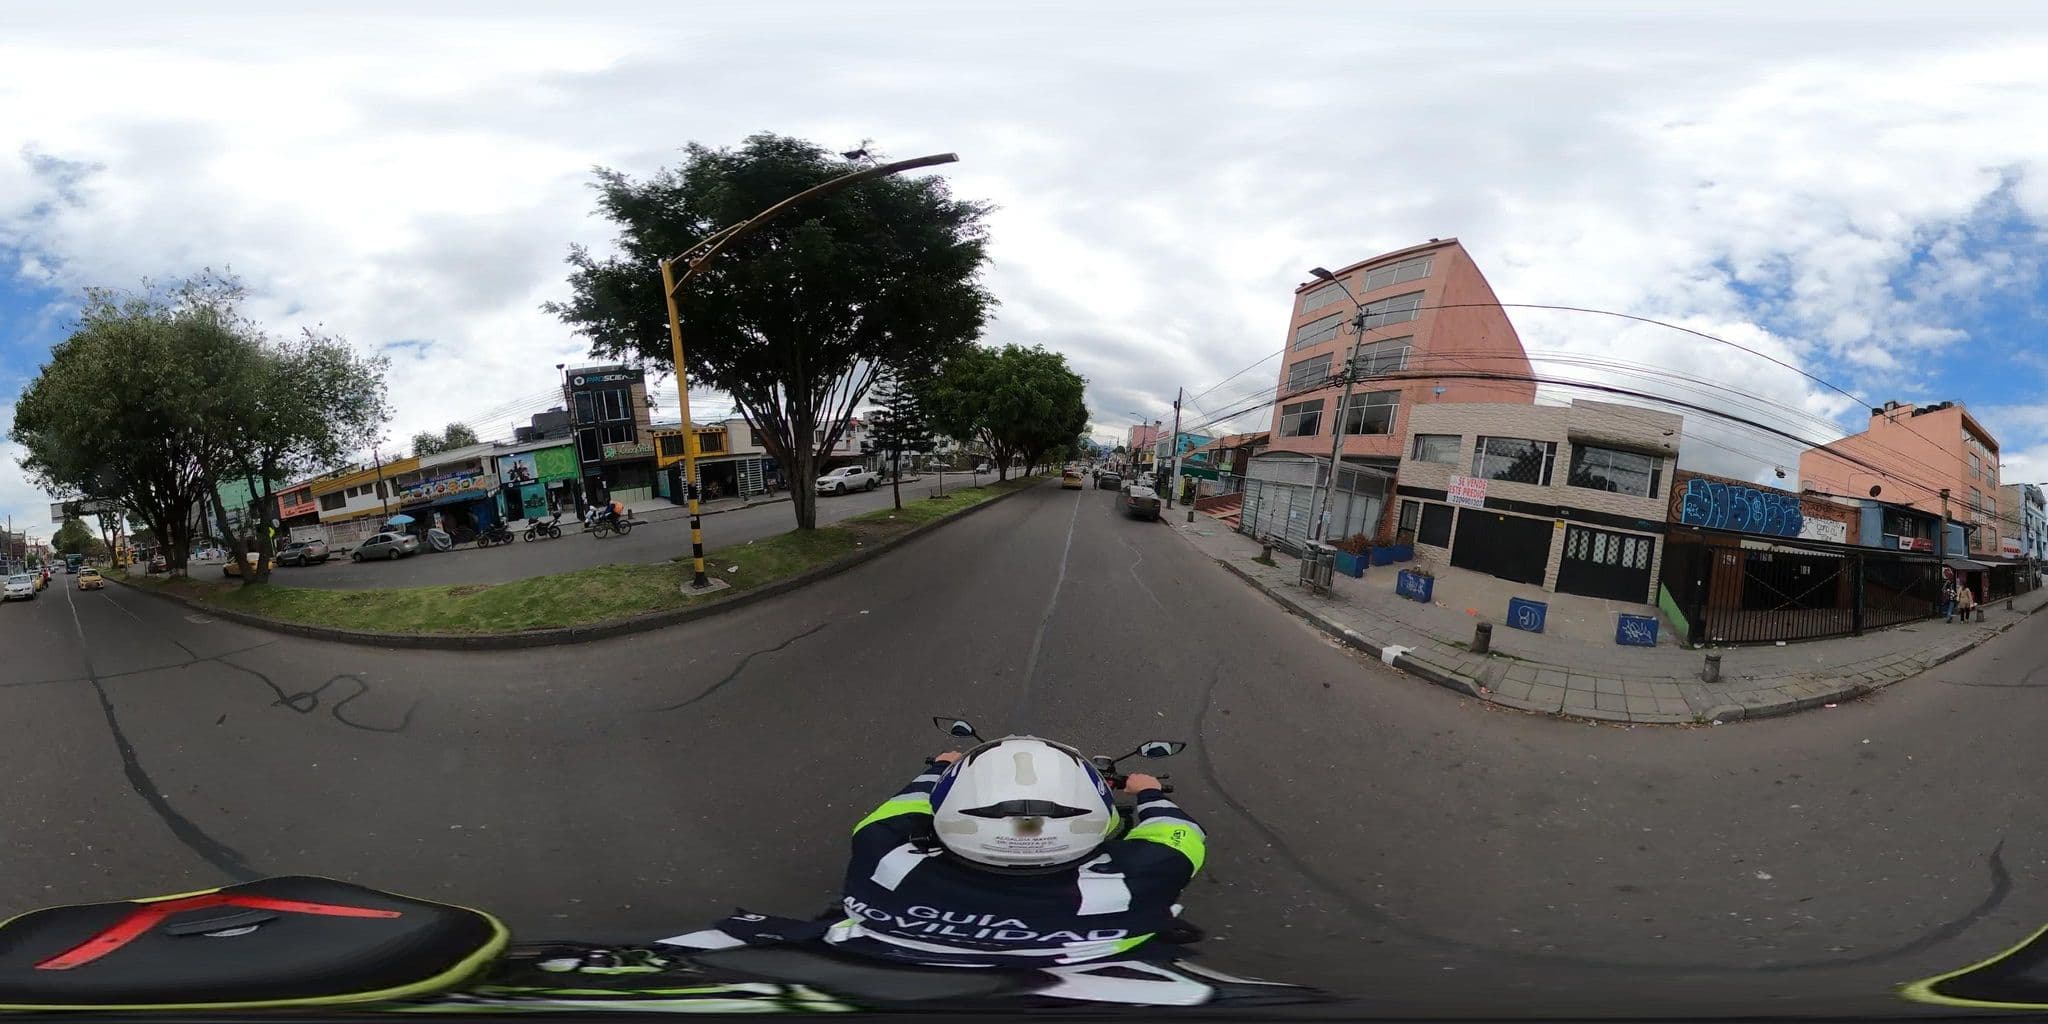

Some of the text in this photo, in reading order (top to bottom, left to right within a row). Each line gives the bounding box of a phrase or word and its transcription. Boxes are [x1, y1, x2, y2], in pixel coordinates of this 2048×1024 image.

[1457, 476, 1488, 490] SE VENDE
[1448, 485, 1485, 499] ESTE PREDIO
[842, 895, 1129, 941] MOVILIDAD
